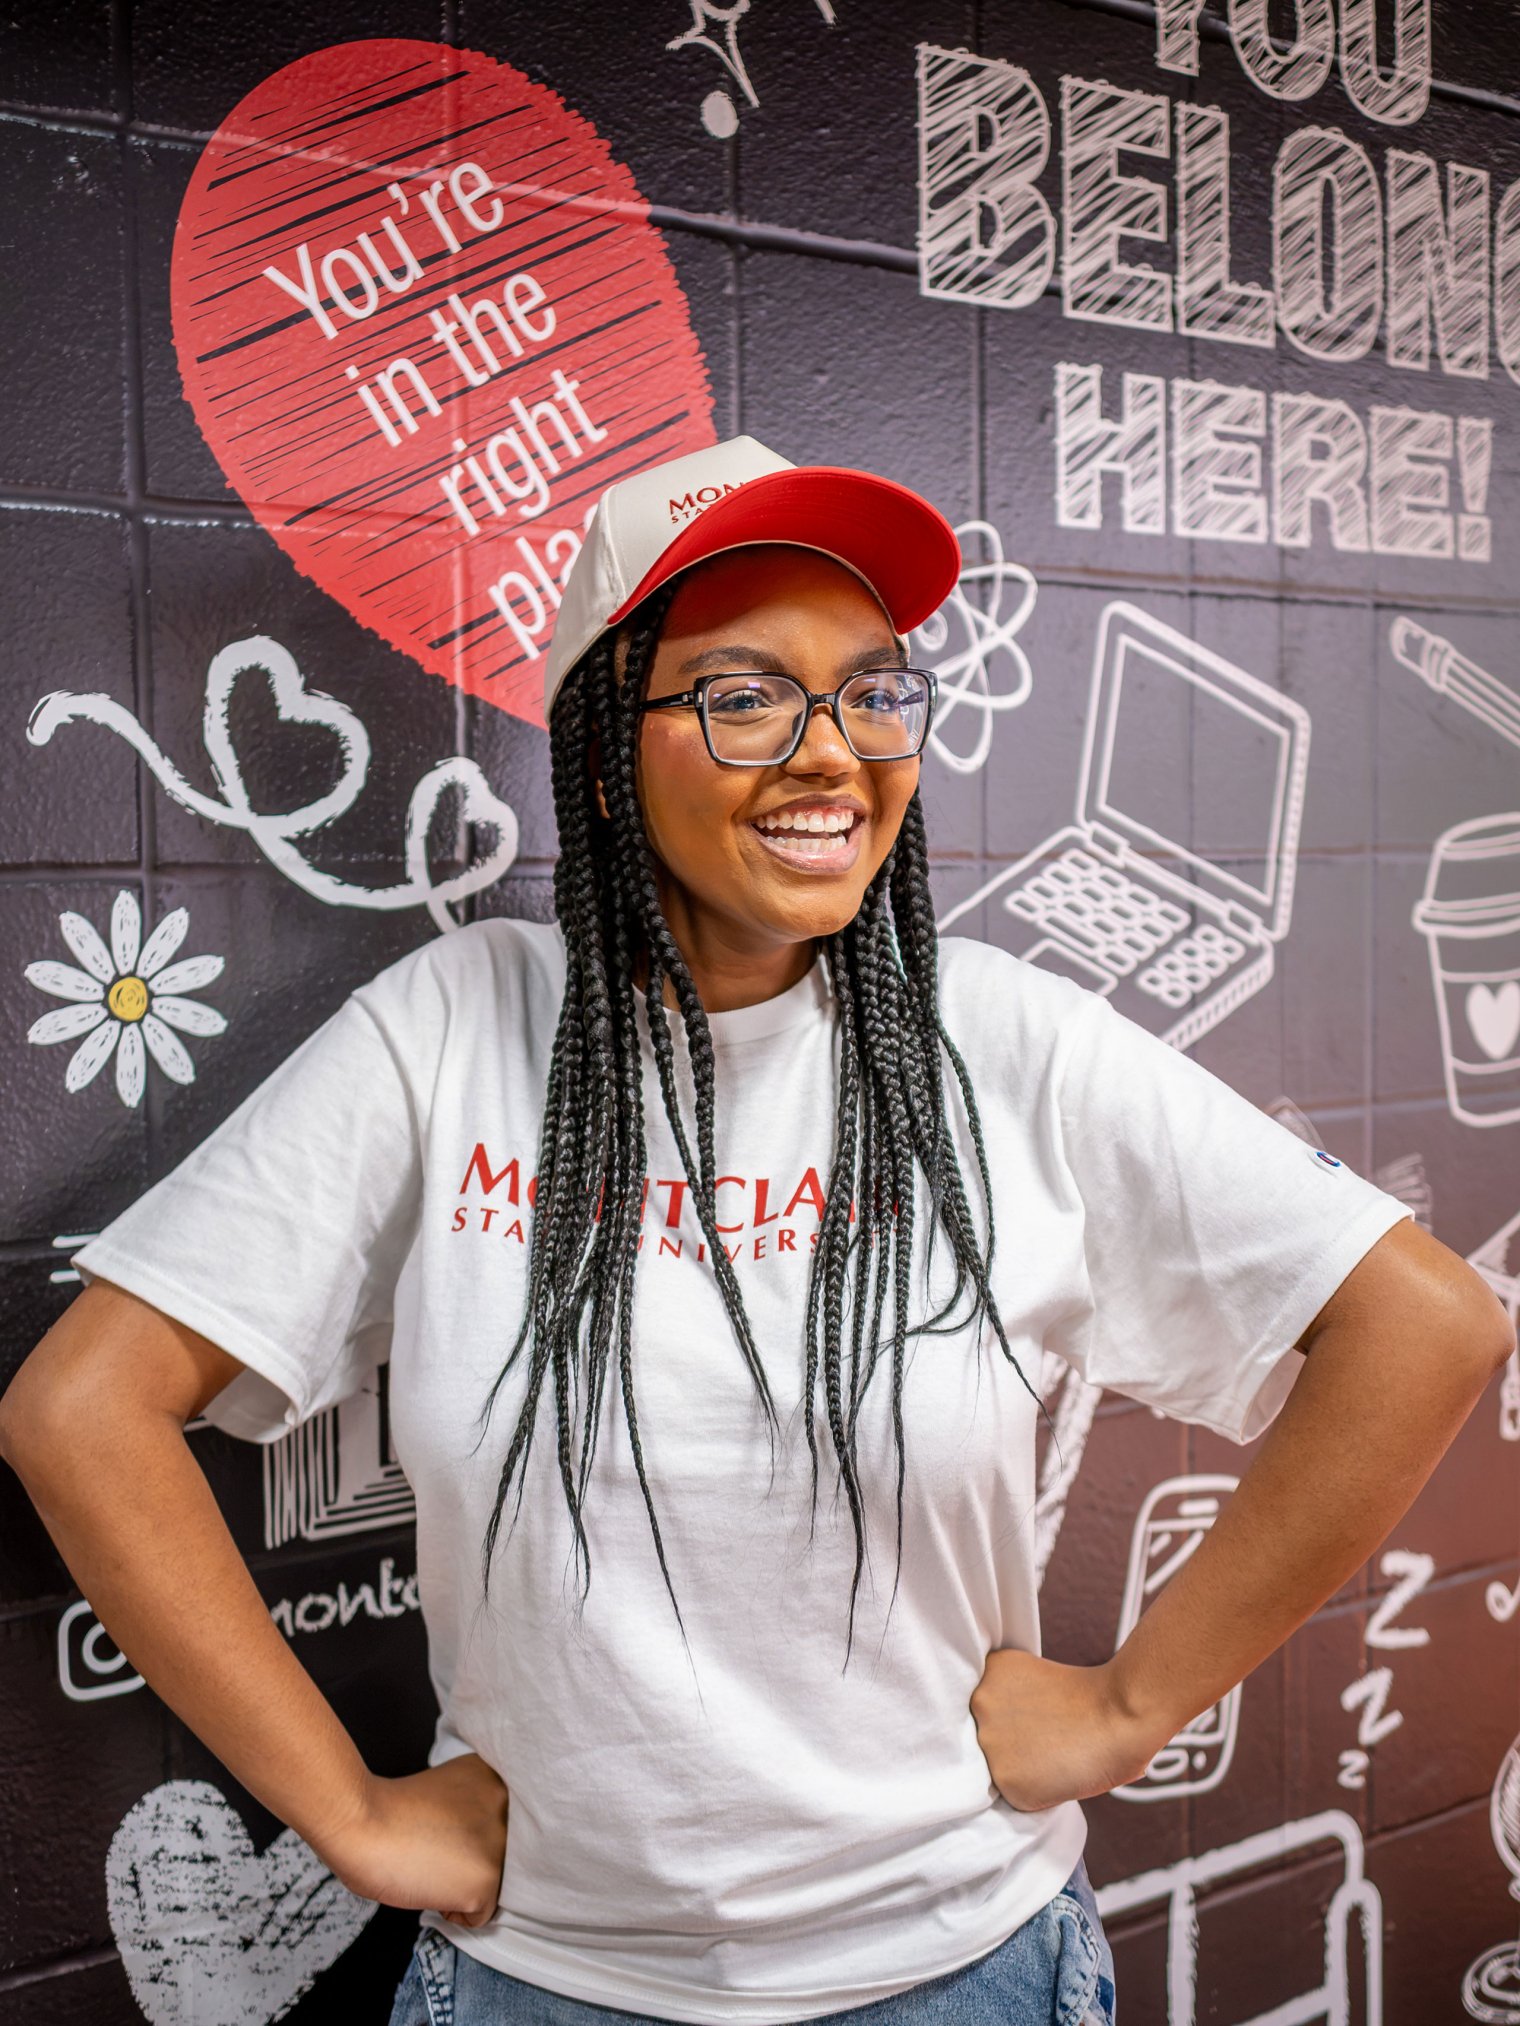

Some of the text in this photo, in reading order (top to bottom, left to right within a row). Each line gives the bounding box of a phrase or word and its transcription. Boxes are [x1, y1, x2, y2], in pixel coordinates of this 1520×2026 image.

[262, 162, 504, 340] You're
[915, 42, 1520, 386] BELON
[345, 273, 557, 448] in the
[438, 369, 608, 536] right
[671, 503, 713, 524] STA
[1054, 361, 1493, 562] HERE!
[487, 502, 599, 660] pla
[451, 1206, 525, 1244] STA
